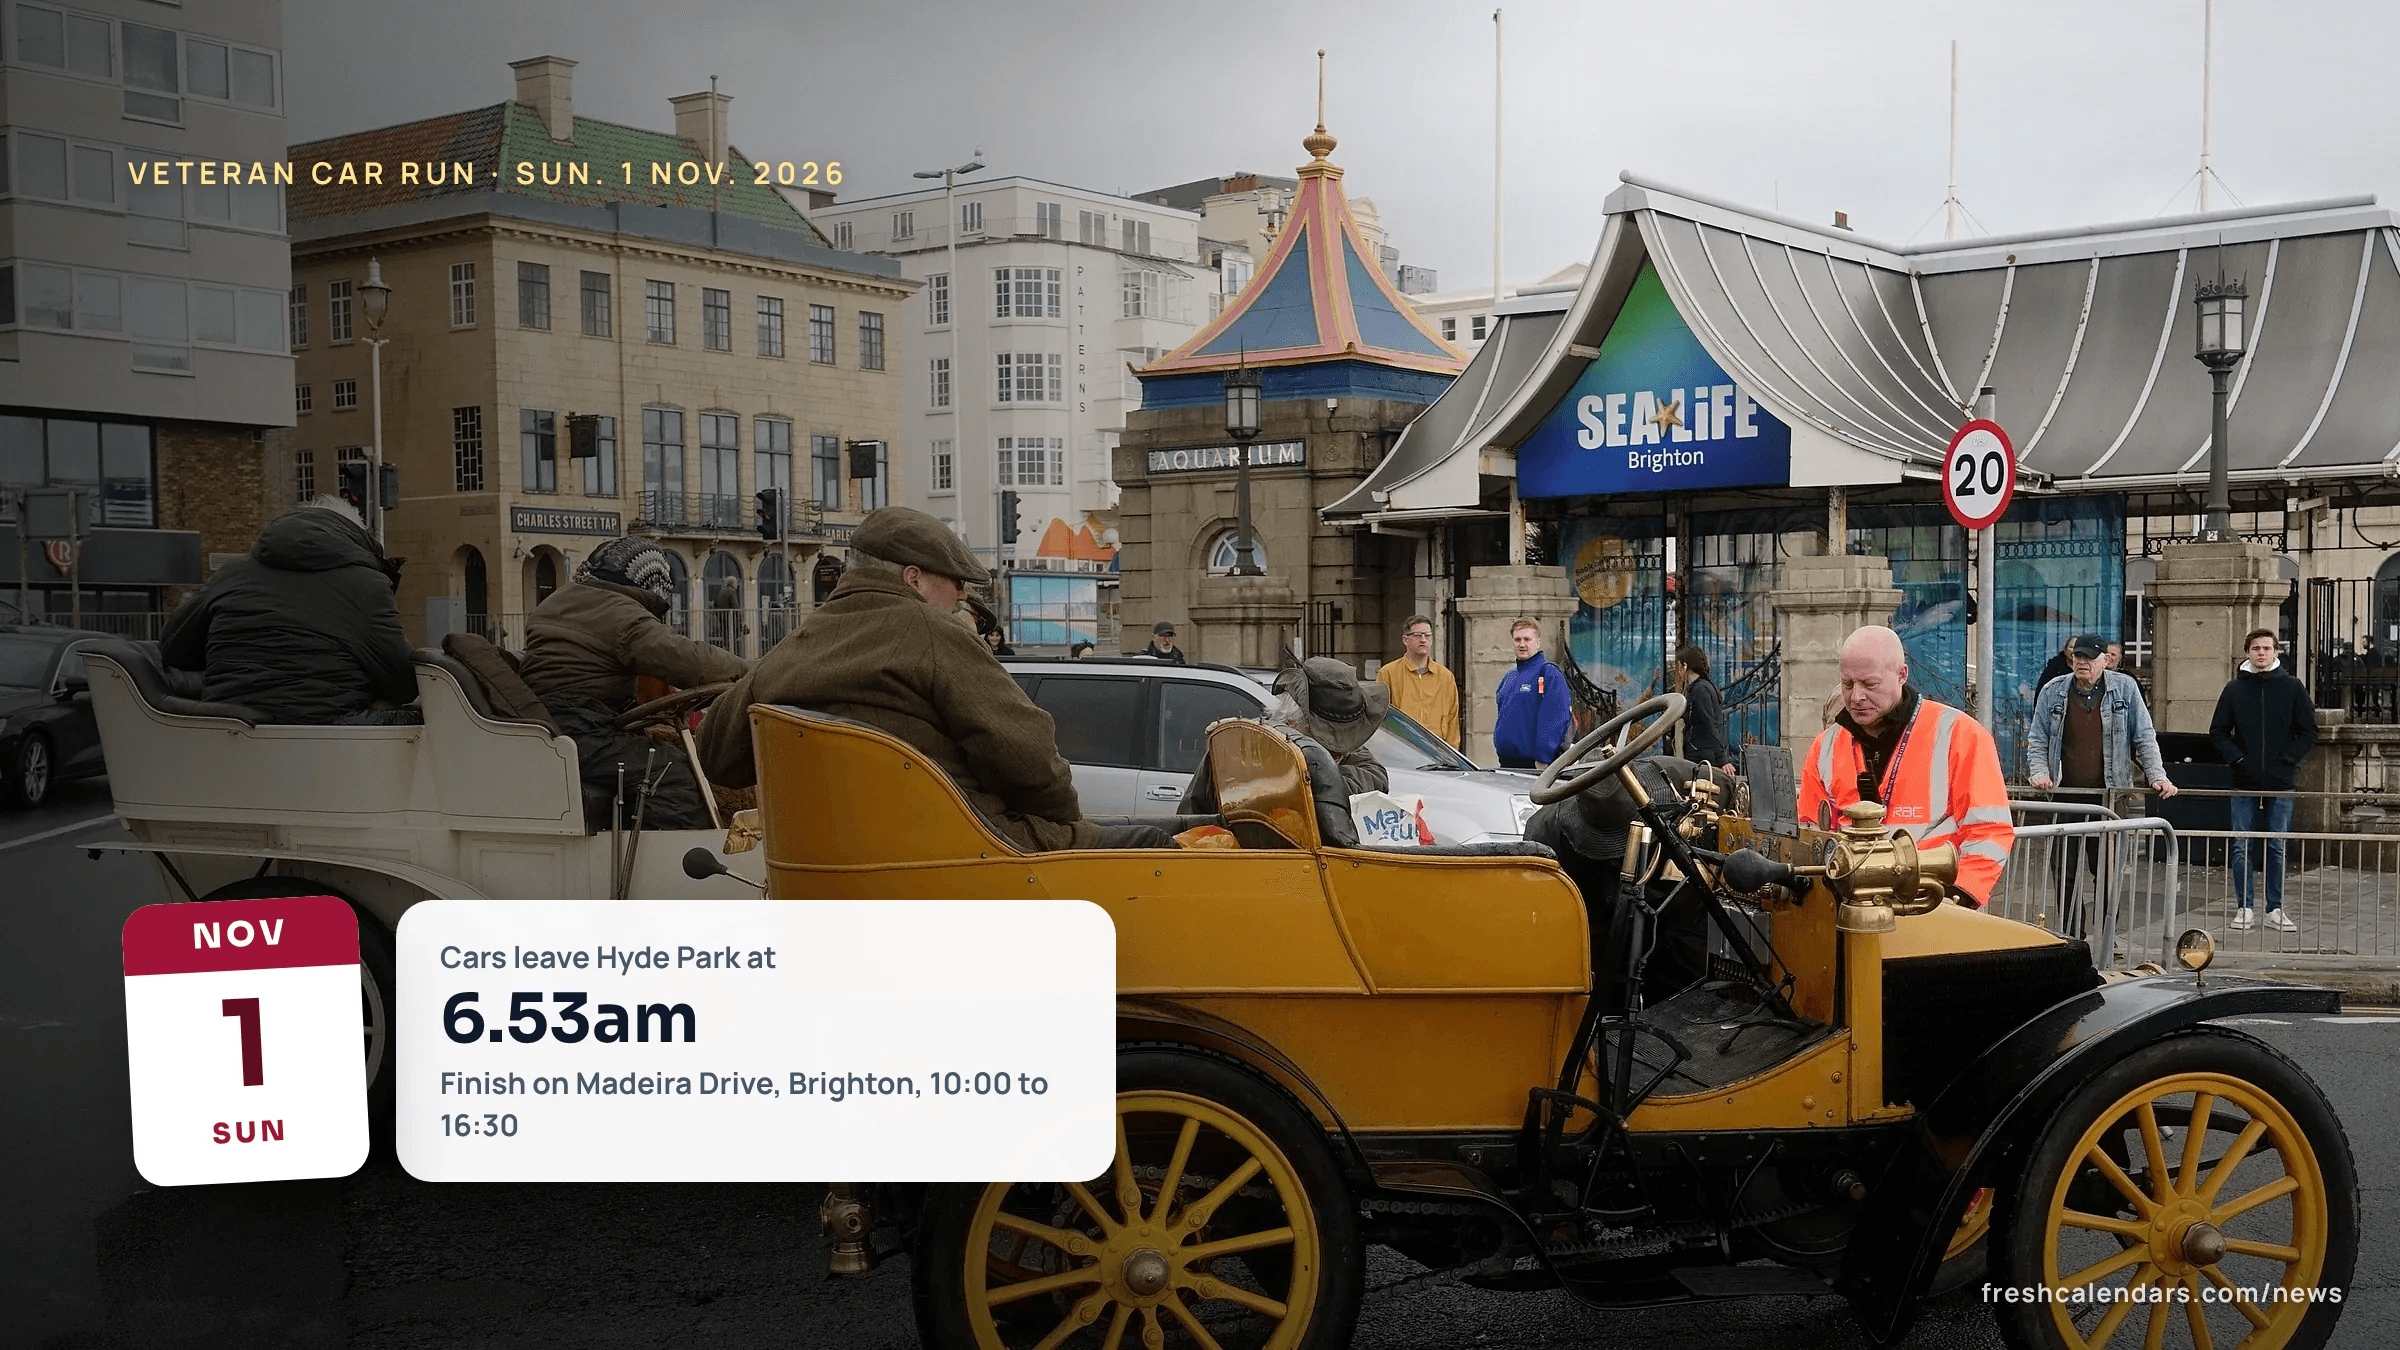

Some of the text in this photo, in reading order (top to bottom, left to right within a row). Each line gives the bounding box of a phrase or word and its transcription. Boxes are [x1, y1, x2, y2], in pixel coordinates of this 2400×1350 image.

[1077, 266, 1086, 413] PATTERNS
[1577, 391, 1661, 450] SEA
[1156, 442, 1297, 471] AQUARIUM
[1628, 448, 1704, 473] Brighton
[1954, 450, 2005, 497] 20
[516, 512, 617, 531] CHARLES STREET TAP
